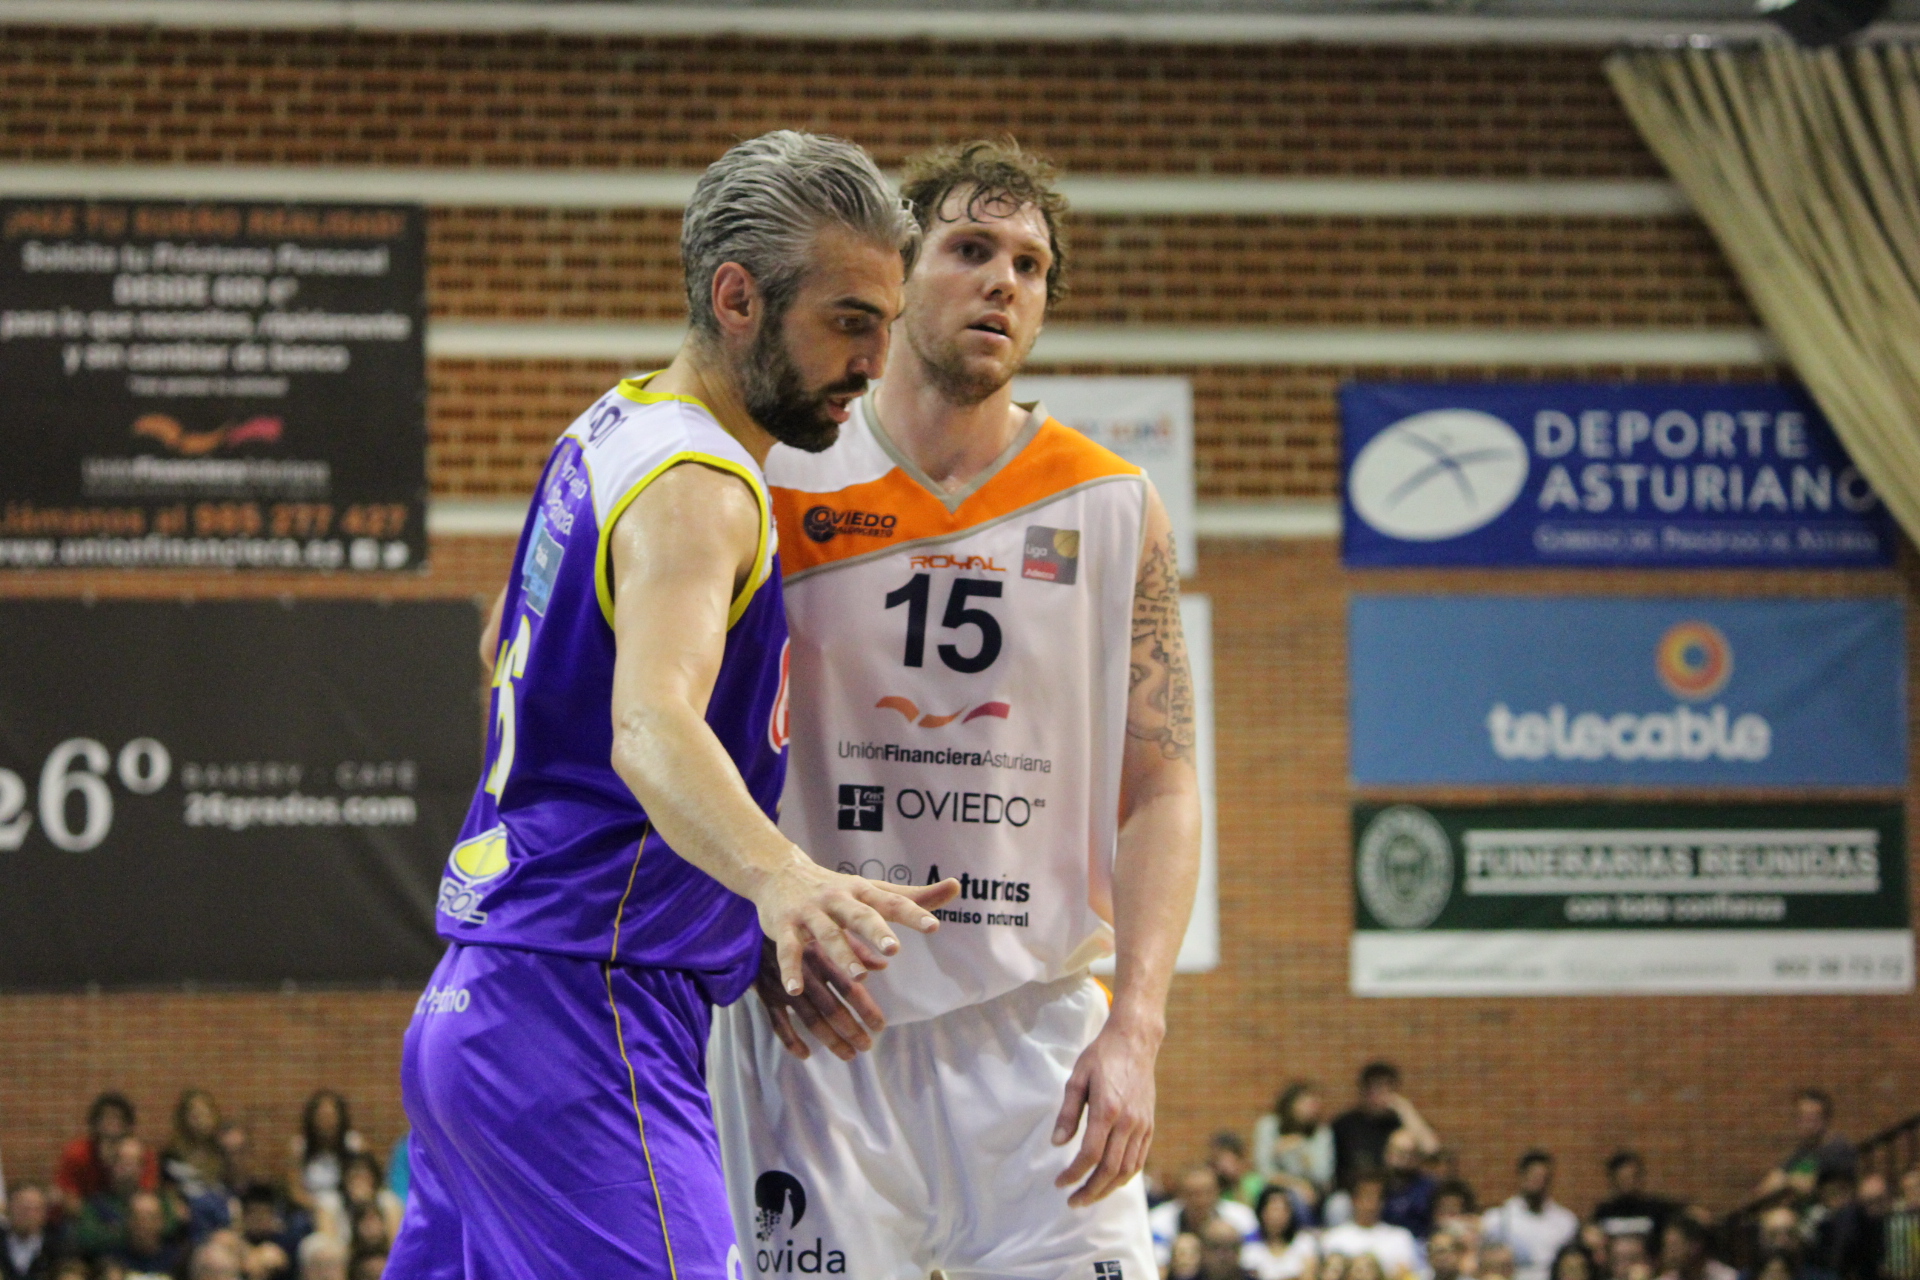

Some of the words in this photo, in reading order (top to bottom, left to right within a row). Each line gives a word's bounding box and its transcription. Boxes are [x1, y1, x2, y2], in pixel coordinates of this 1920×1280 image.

[1533, 409, 1808, 459] DEPORTE
[812, 508, 897, 529] OVIEDO
[910, 554, 1006, 572] ROYAL
[1025, 543, 1047, 558] Liga
[885, 573, 1003, 674] 15
[1486, 703, 1772, 760] telecable
[184, 792, 418, 830] 26grados.com
[897, 788, 1031, 827] OVIEDO
[1467, 845, 1691, 880] FUNERARIAS
[1700, 845, 1878, 880] REUNIDAS
[926, 864, 1030, 903] Aturias
[756, 1238, 845, 1274] ovida
